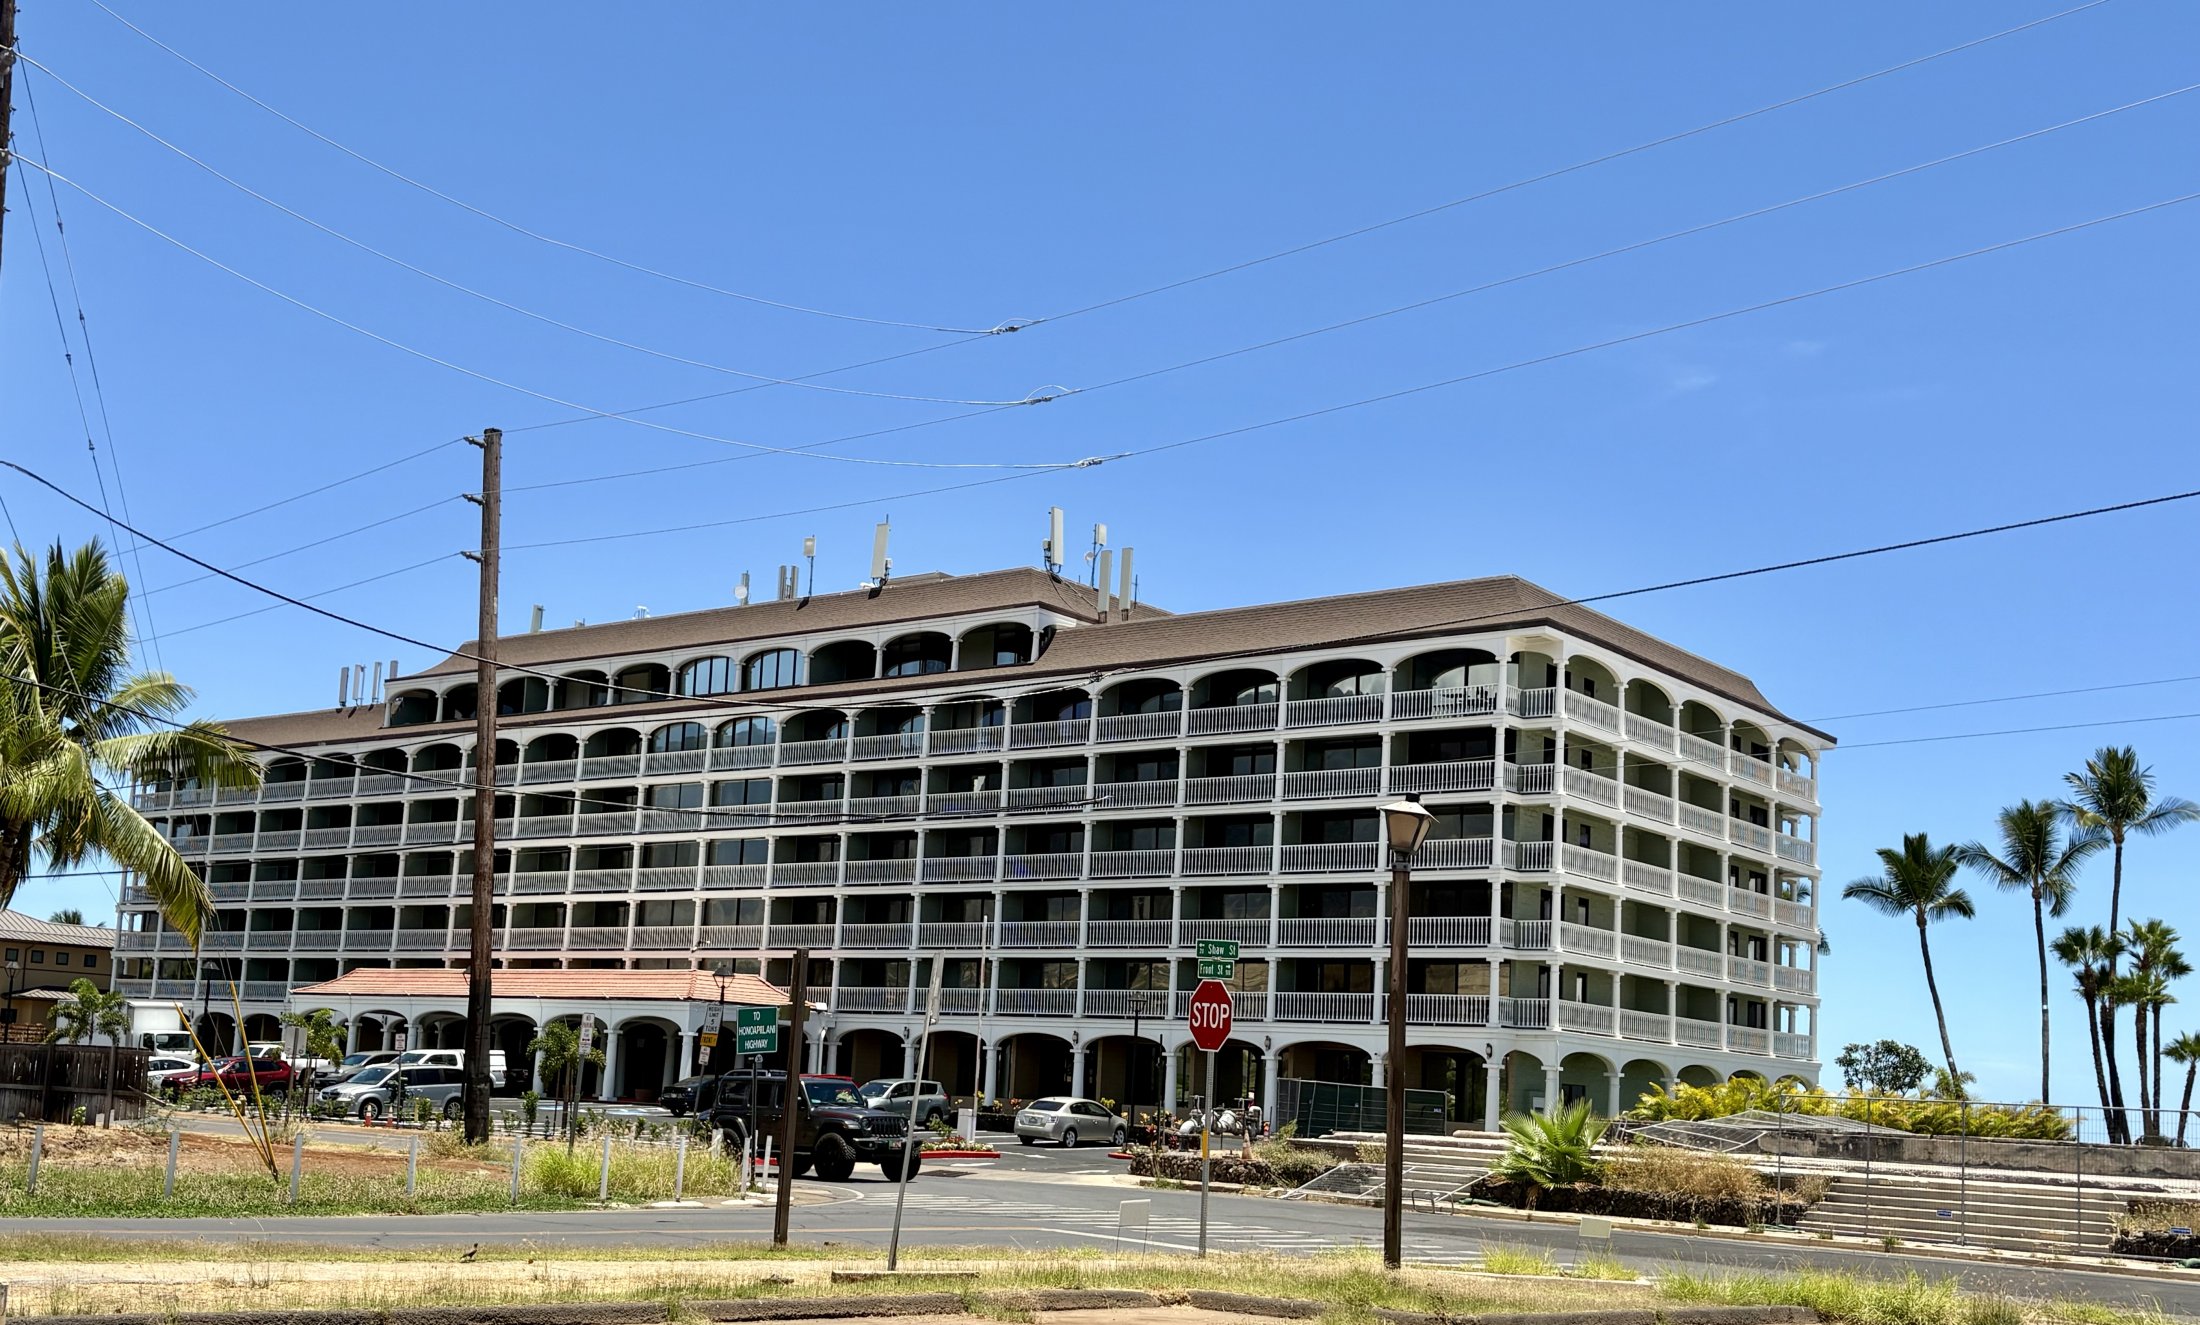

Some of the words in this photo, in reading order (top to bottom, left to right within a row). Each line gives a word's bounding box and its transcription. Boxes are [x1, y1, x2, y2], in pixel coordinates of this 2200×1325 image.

[1207, 943, 1225, 955] Shaw
[1228, 944, 1236, 956] St
[1199, 963, 1214, 975] Front
[1217, 964, 1223, 975] St
[753, 1011, 760, 1021] TO
[1192, 1002, 1230, 1029] STOP
[744, 1039, 768, 1050] HIGHWAY
